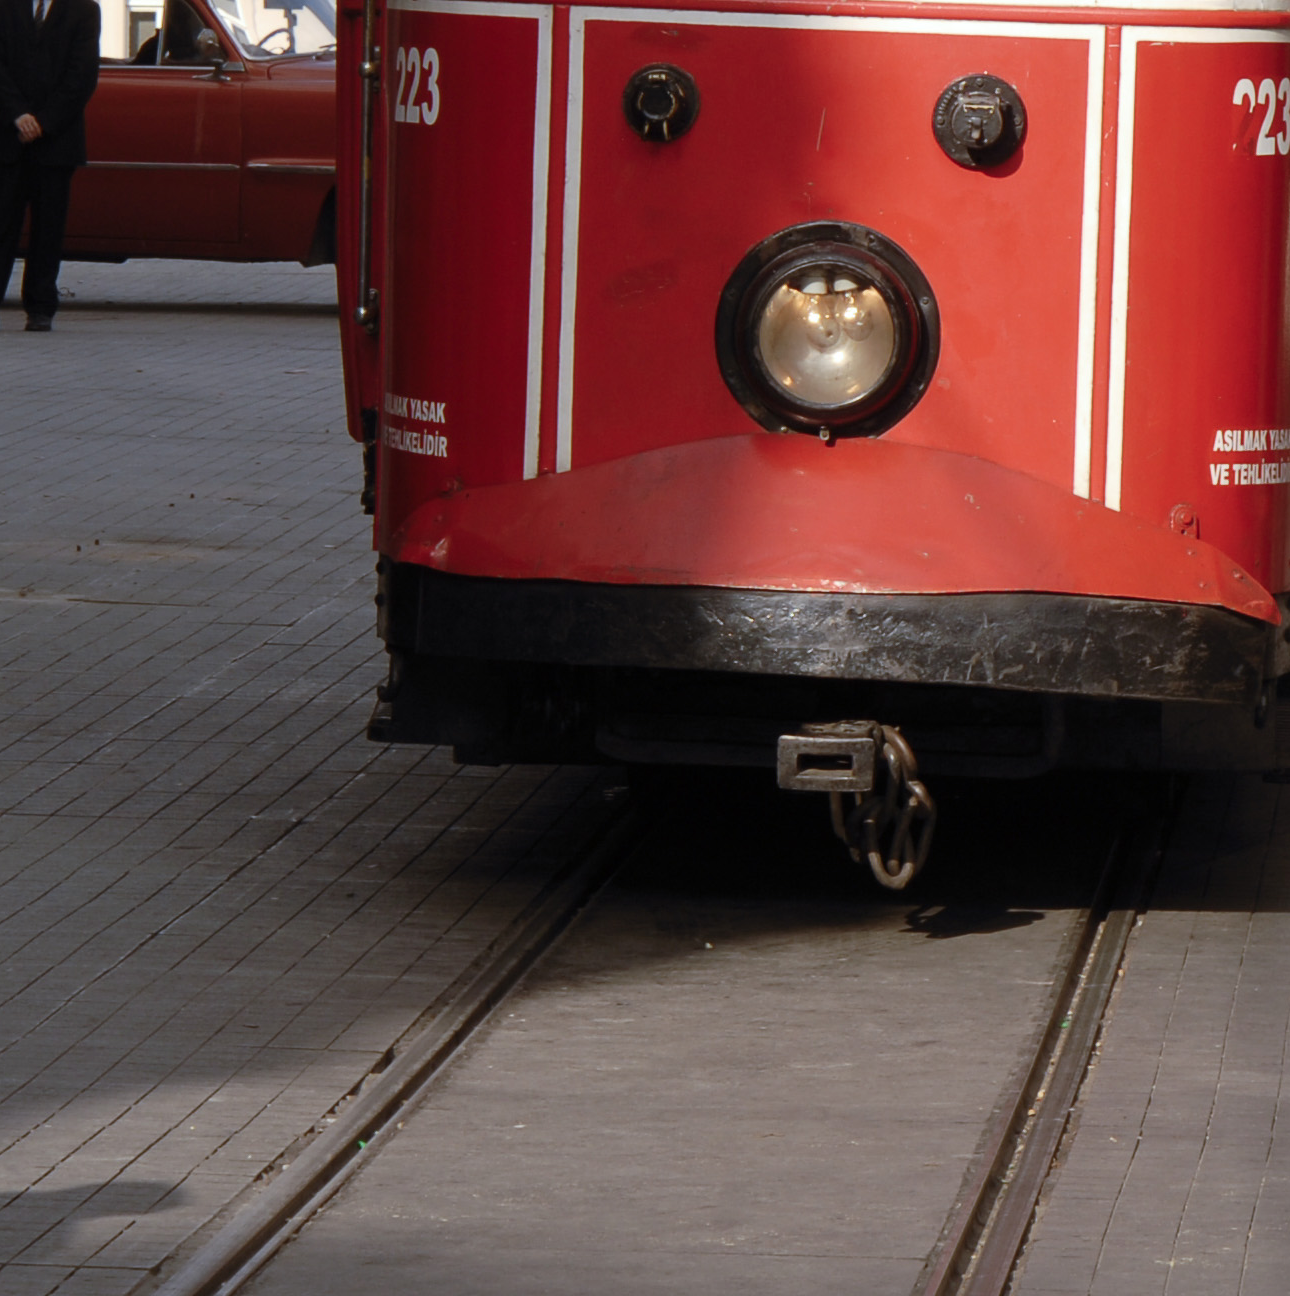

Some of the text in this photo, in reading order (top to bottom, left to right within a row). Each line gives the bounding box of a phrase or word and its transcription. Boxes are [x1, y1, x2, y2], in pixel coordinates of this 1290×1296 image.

[394, 46, 440, 126] 223
[410, 398, 446, 424] YASAK
[1213, 429, 1268, 452] ASILMAK
[1210, 463, 1230, 486] VE
